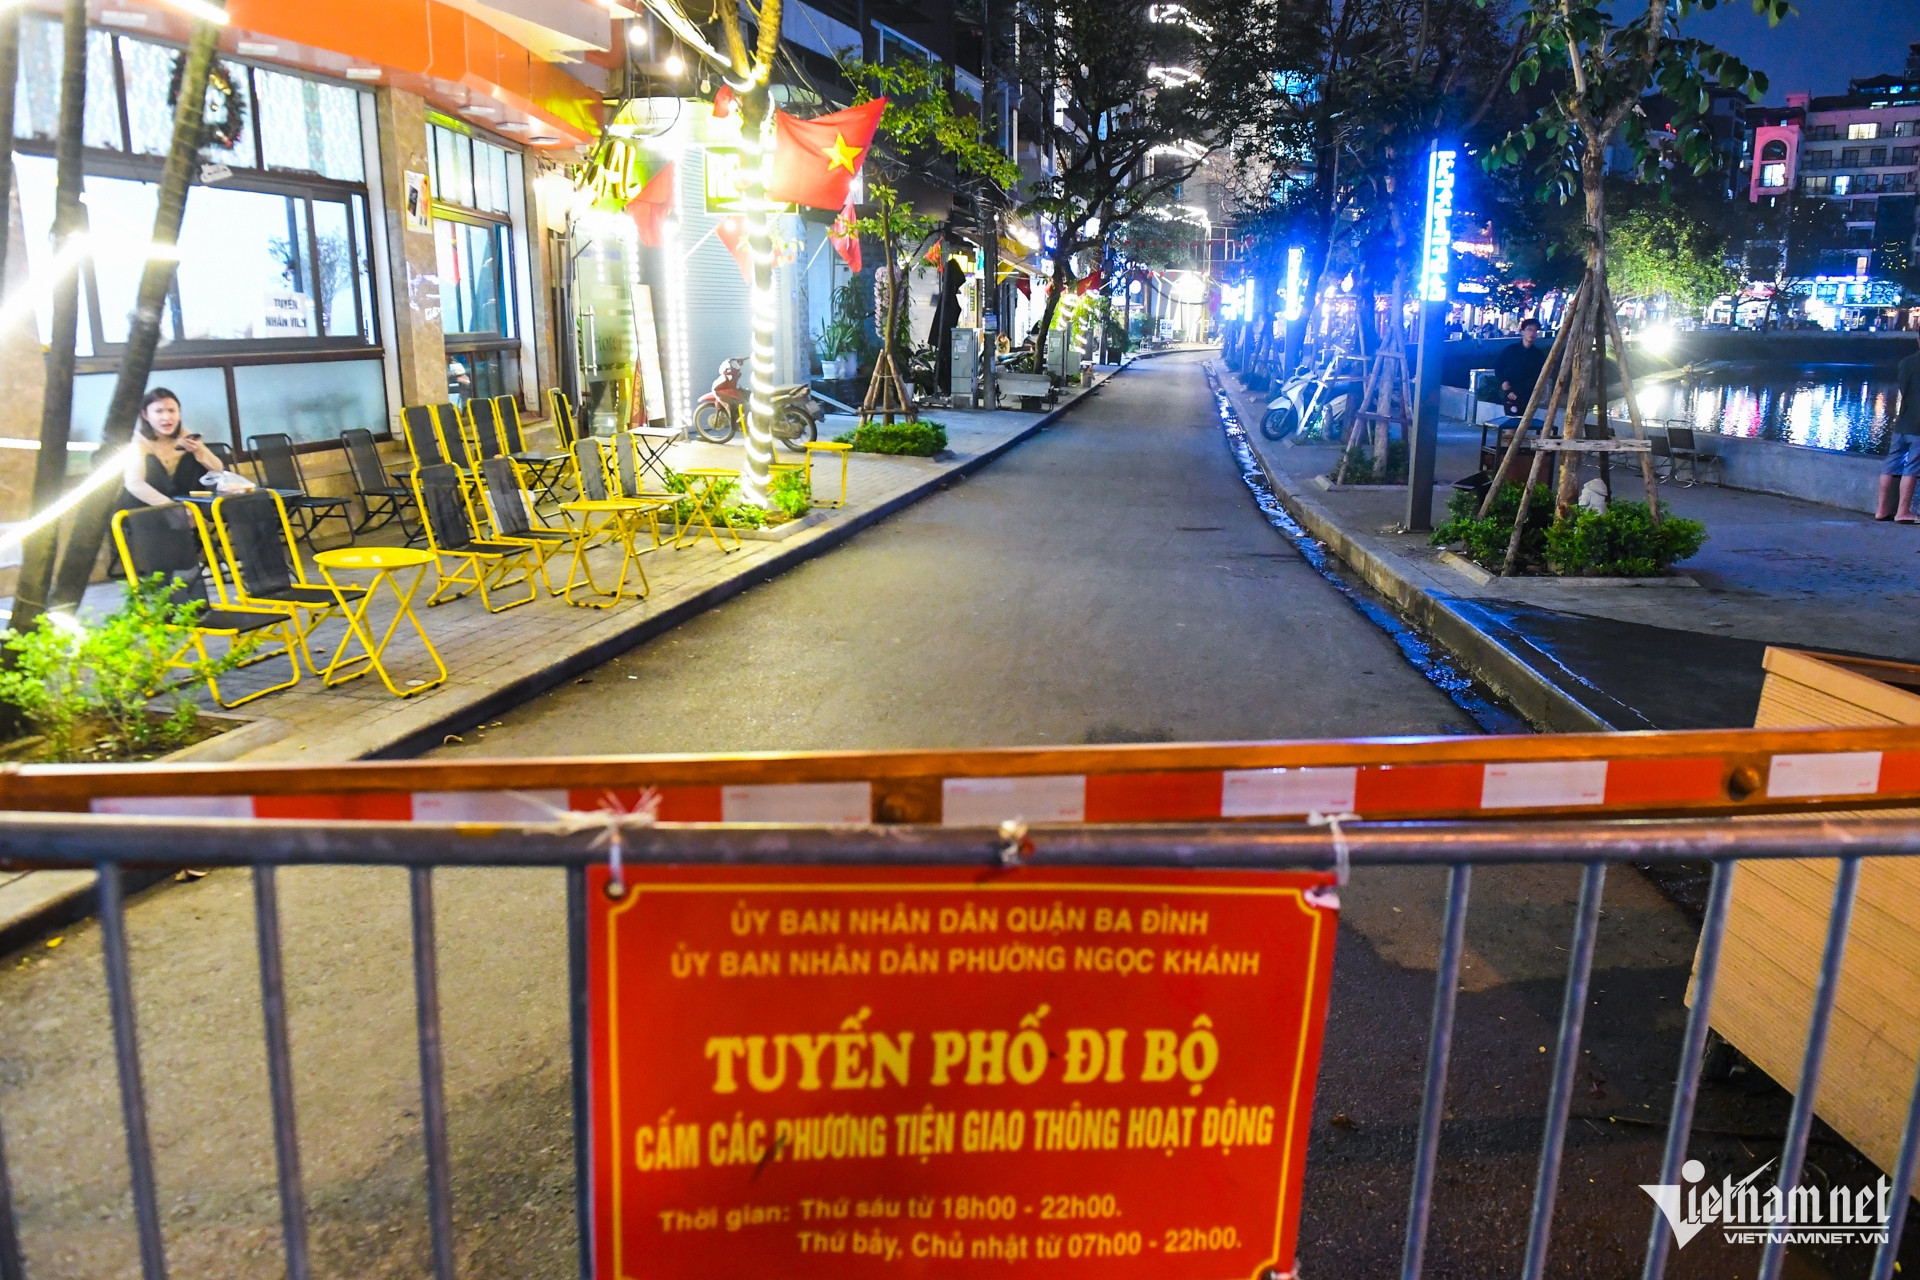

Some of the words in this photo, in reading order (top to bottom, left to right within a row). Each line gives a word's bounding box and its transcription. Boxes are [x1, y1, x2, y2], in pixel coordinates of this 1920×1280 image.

[779, 909, 840, 935] BAN
[1094, 908, 1132, 932] BA
[720, 951, 780, 977] BAN
[1075, 947, 1155, 976] NGỌC
[1164, 946, 1259, 975] KHÁNH
[705, 1007, 913, 1093] TUYẾN
[931, 1004, 1050, 1085] PHỐ
[1063, 1029, 1127, 1083] ĐI
[1141, 1014, 1218, 1096] BỘ
[635, 1110, 699, 1171] CẤM
[709, 1112, 766, 1166] CÁC
[775, 1114, 886, 1161] PHƯƠNG
[895, 1104, 955, 1163] TIỆN
[962, 1110, 1025, 1152] GIAO
[1034, 1101, 1120, 1150] THÔNG
[1127, 1107, 1196, 1156] HOẠT
[1202, 1098, 1274, 1155] ĐỘNG
[726, 1205, 788, 1231] gian:
[856, 1198, 900, 1217] sáu
[943, 1195, 1016, 1220] 18h00
[1041, 1194, 1121, 1219] 22h00.
[1068, 1231, 1141, 1258] 07h00
[1165, 1226, 1241, 1253] 22h00.
